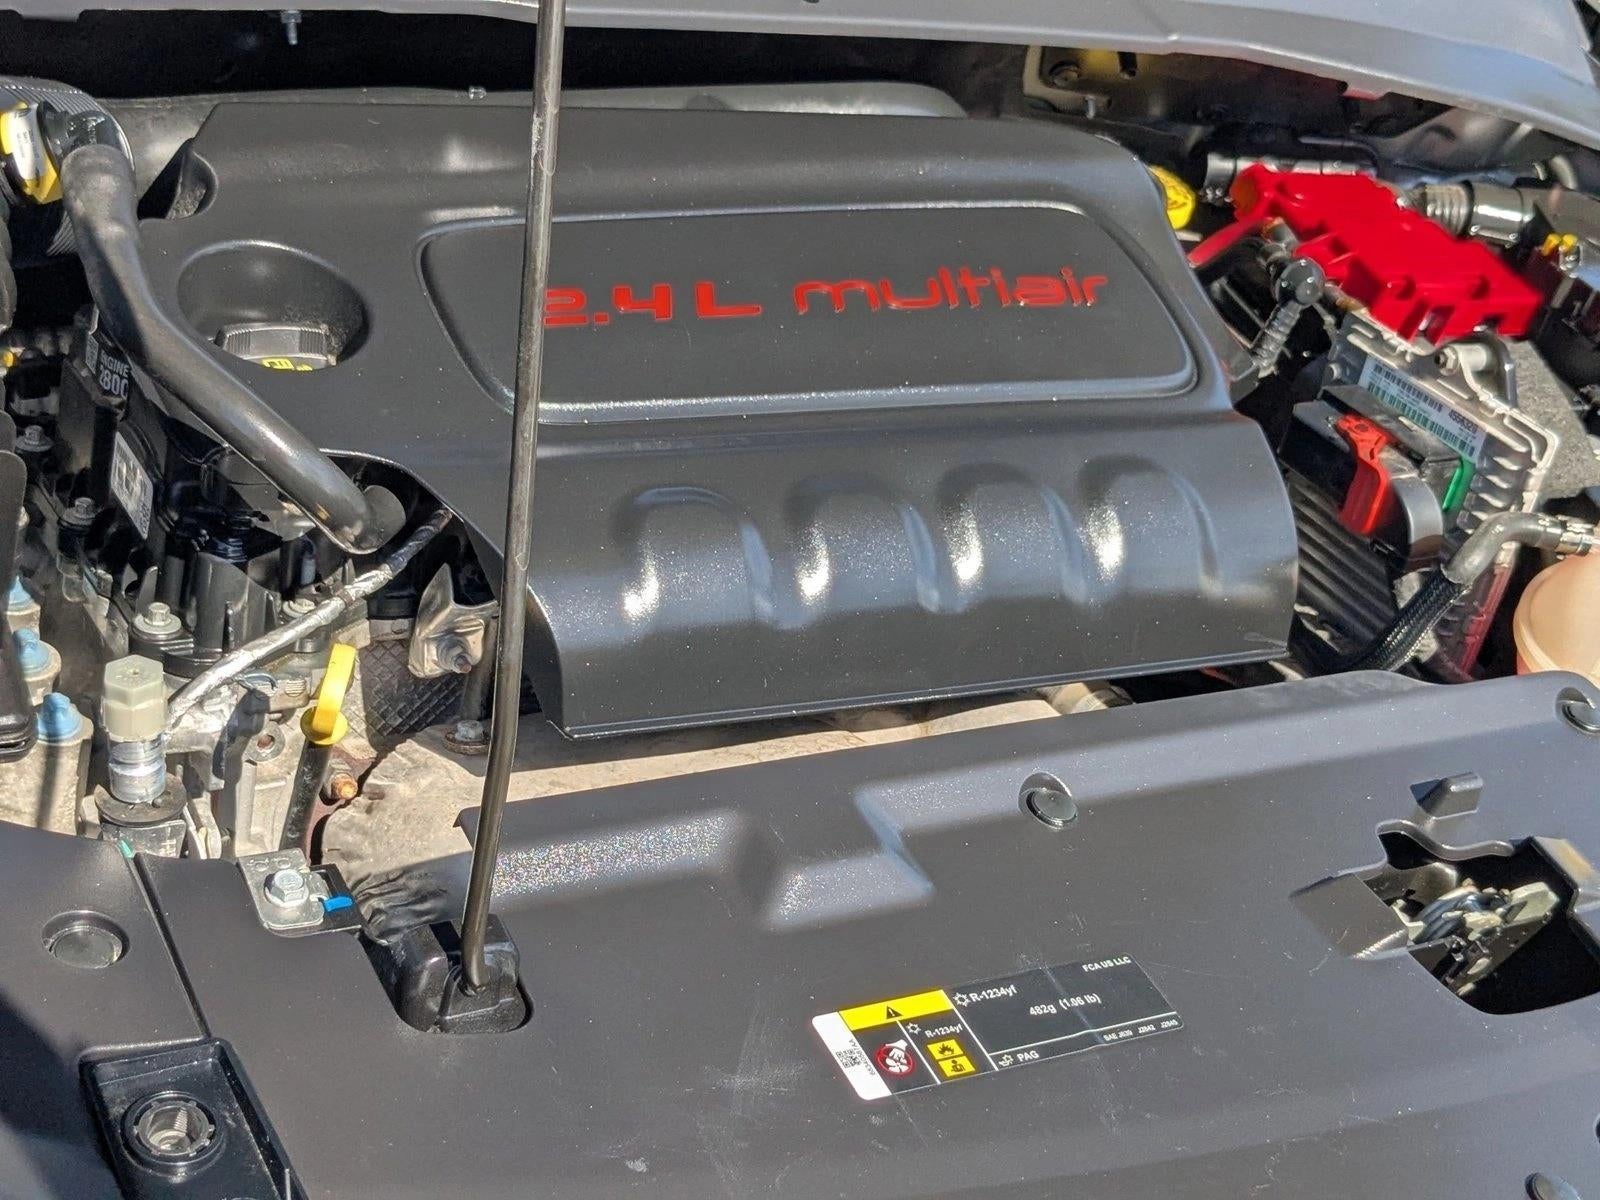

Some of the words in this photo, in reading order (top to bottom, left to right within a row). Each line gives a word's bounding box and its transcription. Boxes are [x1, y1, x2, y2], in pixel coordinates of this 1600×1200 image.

[694, 280, 763, 320] L
[794, 266, 1107, 314] multiair
[1081, 961, 1102, 972] FCA
[1100, 959, 1113, 968] US
[1113, 956, 1132, 966] LLC
[969, 984, 1018, 1002] R-1234yf
[1029, 1003, 1057, 1016] 482g
[925, 1023, 963, 1038] R-1234yf
[1016, 1050, 1040, 1062] PAG
